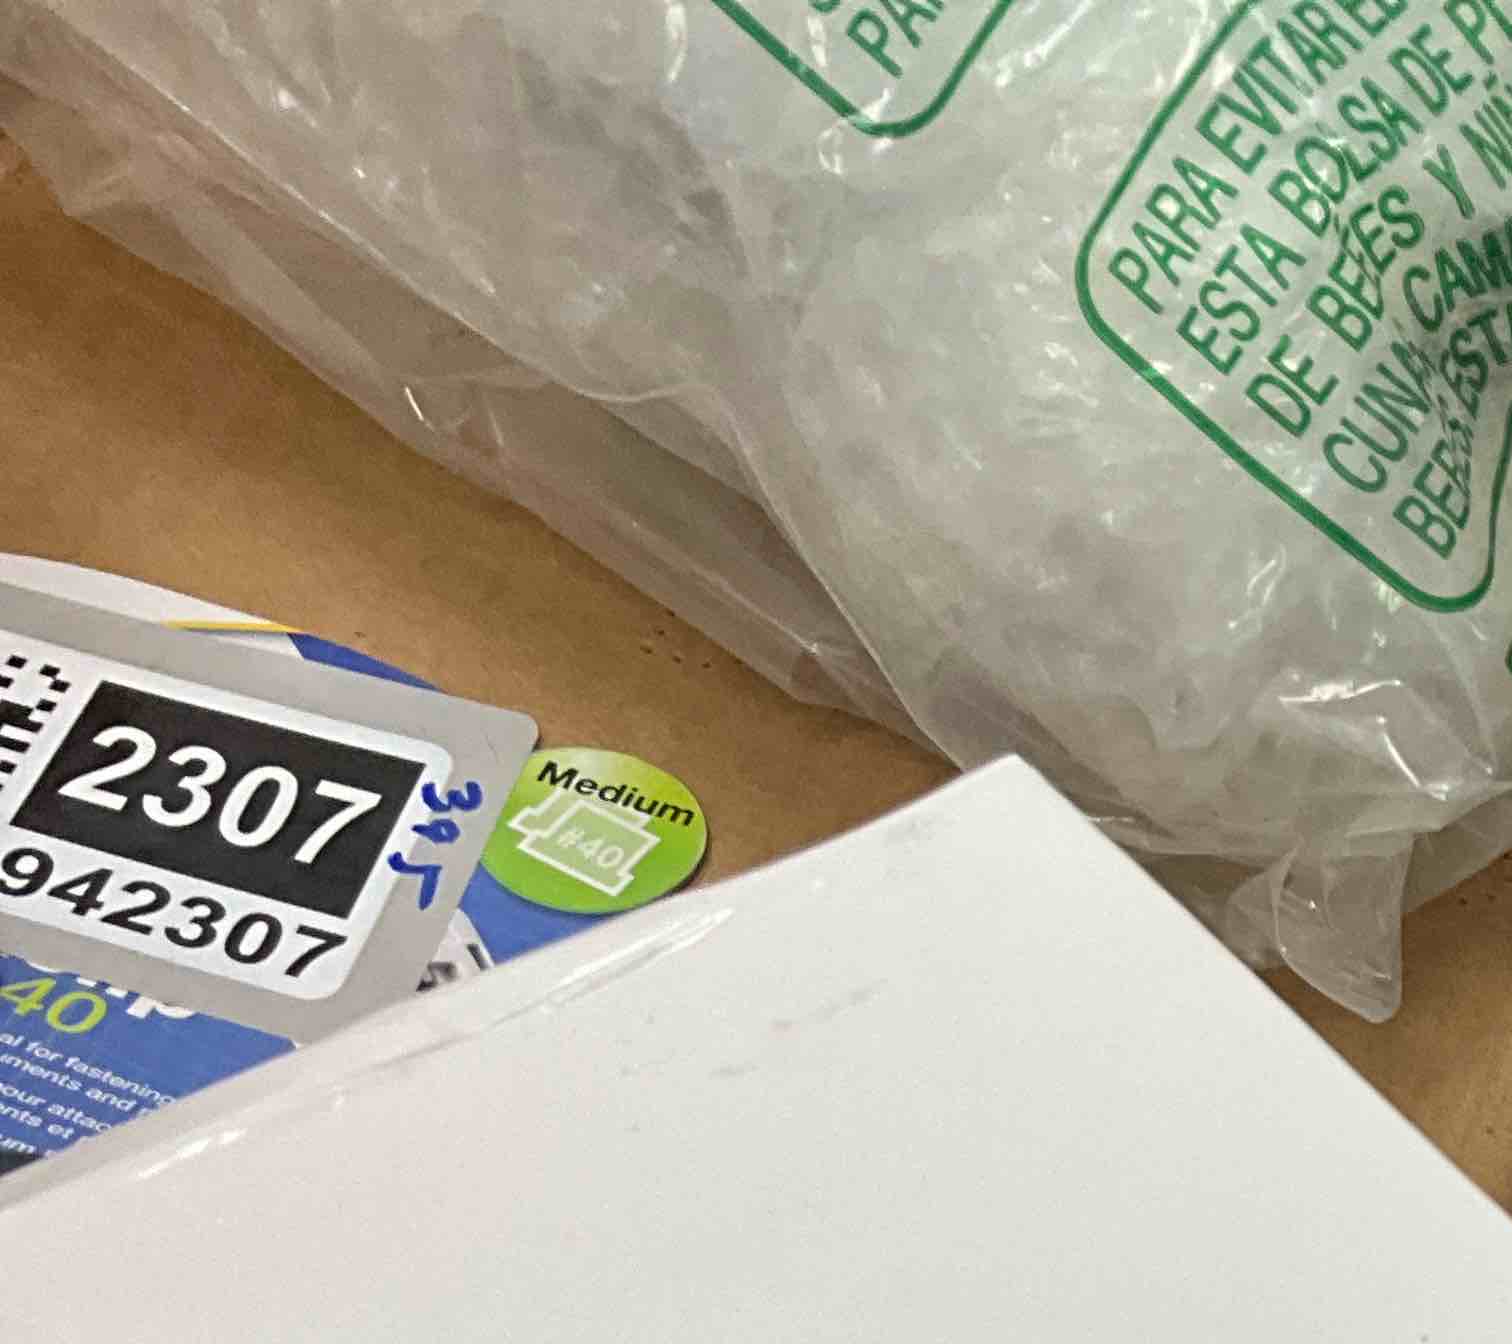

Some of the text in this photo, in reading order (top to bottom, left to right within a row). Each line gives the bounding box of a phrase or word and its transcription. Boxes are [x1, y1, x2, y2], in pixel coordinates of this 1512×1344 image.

[1108, 158, 1239, 314] PARA
[1196, 0, 1365, 174] EVITAR
[1176, 223, 1306, 375] ESTA
[1268, 76, 1425, 238] BOLSA
[1388, 24, 1474, 117] DE
[1245, 333, 1339, 437] DE
[1422, 143, 1476, 220] Y
[57, 724, 382, 866] 2307
[536, 760, 696, 829] Medium
[26, 1041, 63, 1062] for
[85, 1087, 137, 1112] and
